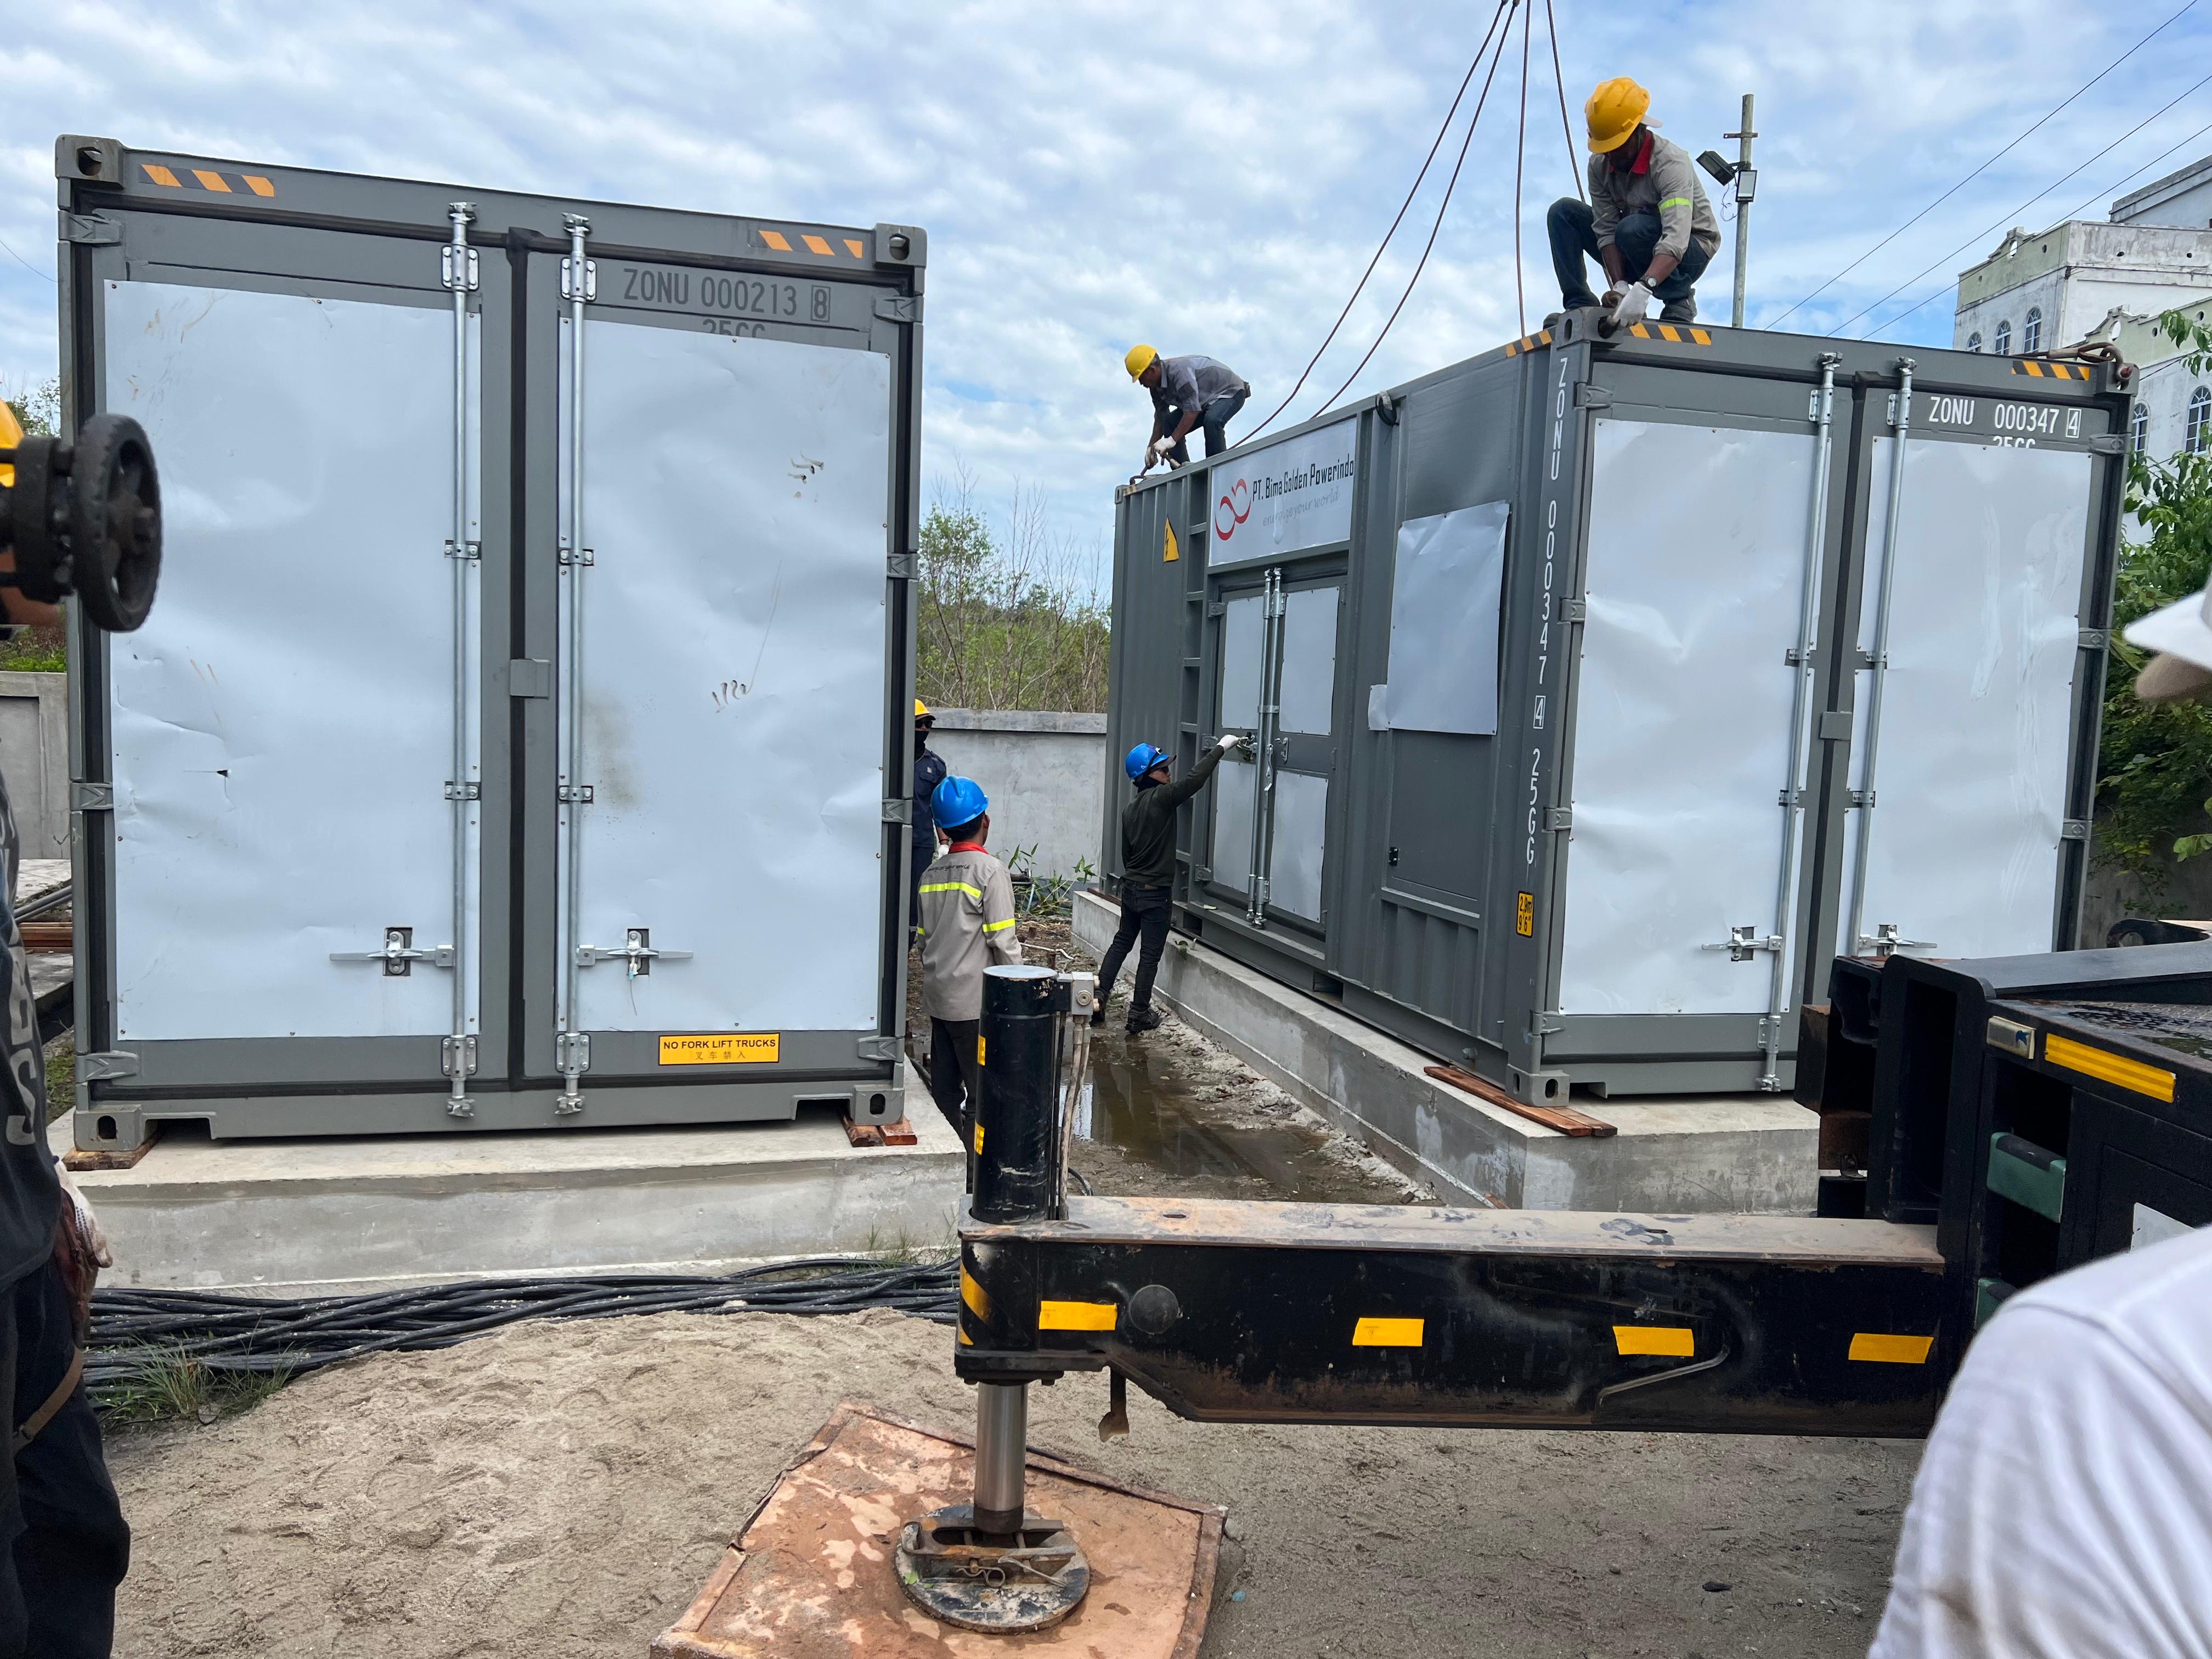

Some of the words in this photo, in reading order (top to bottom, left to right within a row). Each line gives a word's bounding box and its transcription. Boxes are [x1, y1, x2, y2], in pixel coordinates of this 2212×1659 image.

[624, 268, 689, 304] ZONU
[701, 276, 797, 316] 000213
[812, 287, 829, 320] 8
[1551, 357, 1568, 481] ZONU
[1929, 397, 1974, 425] ZONU
[1995, 404, 2059, 433] 000347
[2067, 410, 2080, 437] 4
[1252, 479, 1263, 502] PT.
[1266, 477, 1283, 499] Bima
[1284, 467, 1308, 494] Golden
[1310, 453, 1354, 487] Powerindo
[1314, 486, 1340, 508] world
[1538, 500, 1556, 685] 000347
[1534, 697, 1544, 727] 4
[1526, 748, 1541, 865] 25GG
[663, 1041, 679, 1049] NO
[712, 1040, 733, 1048] LIFT
[736, 1039, 776, 1047] TRUCKS
